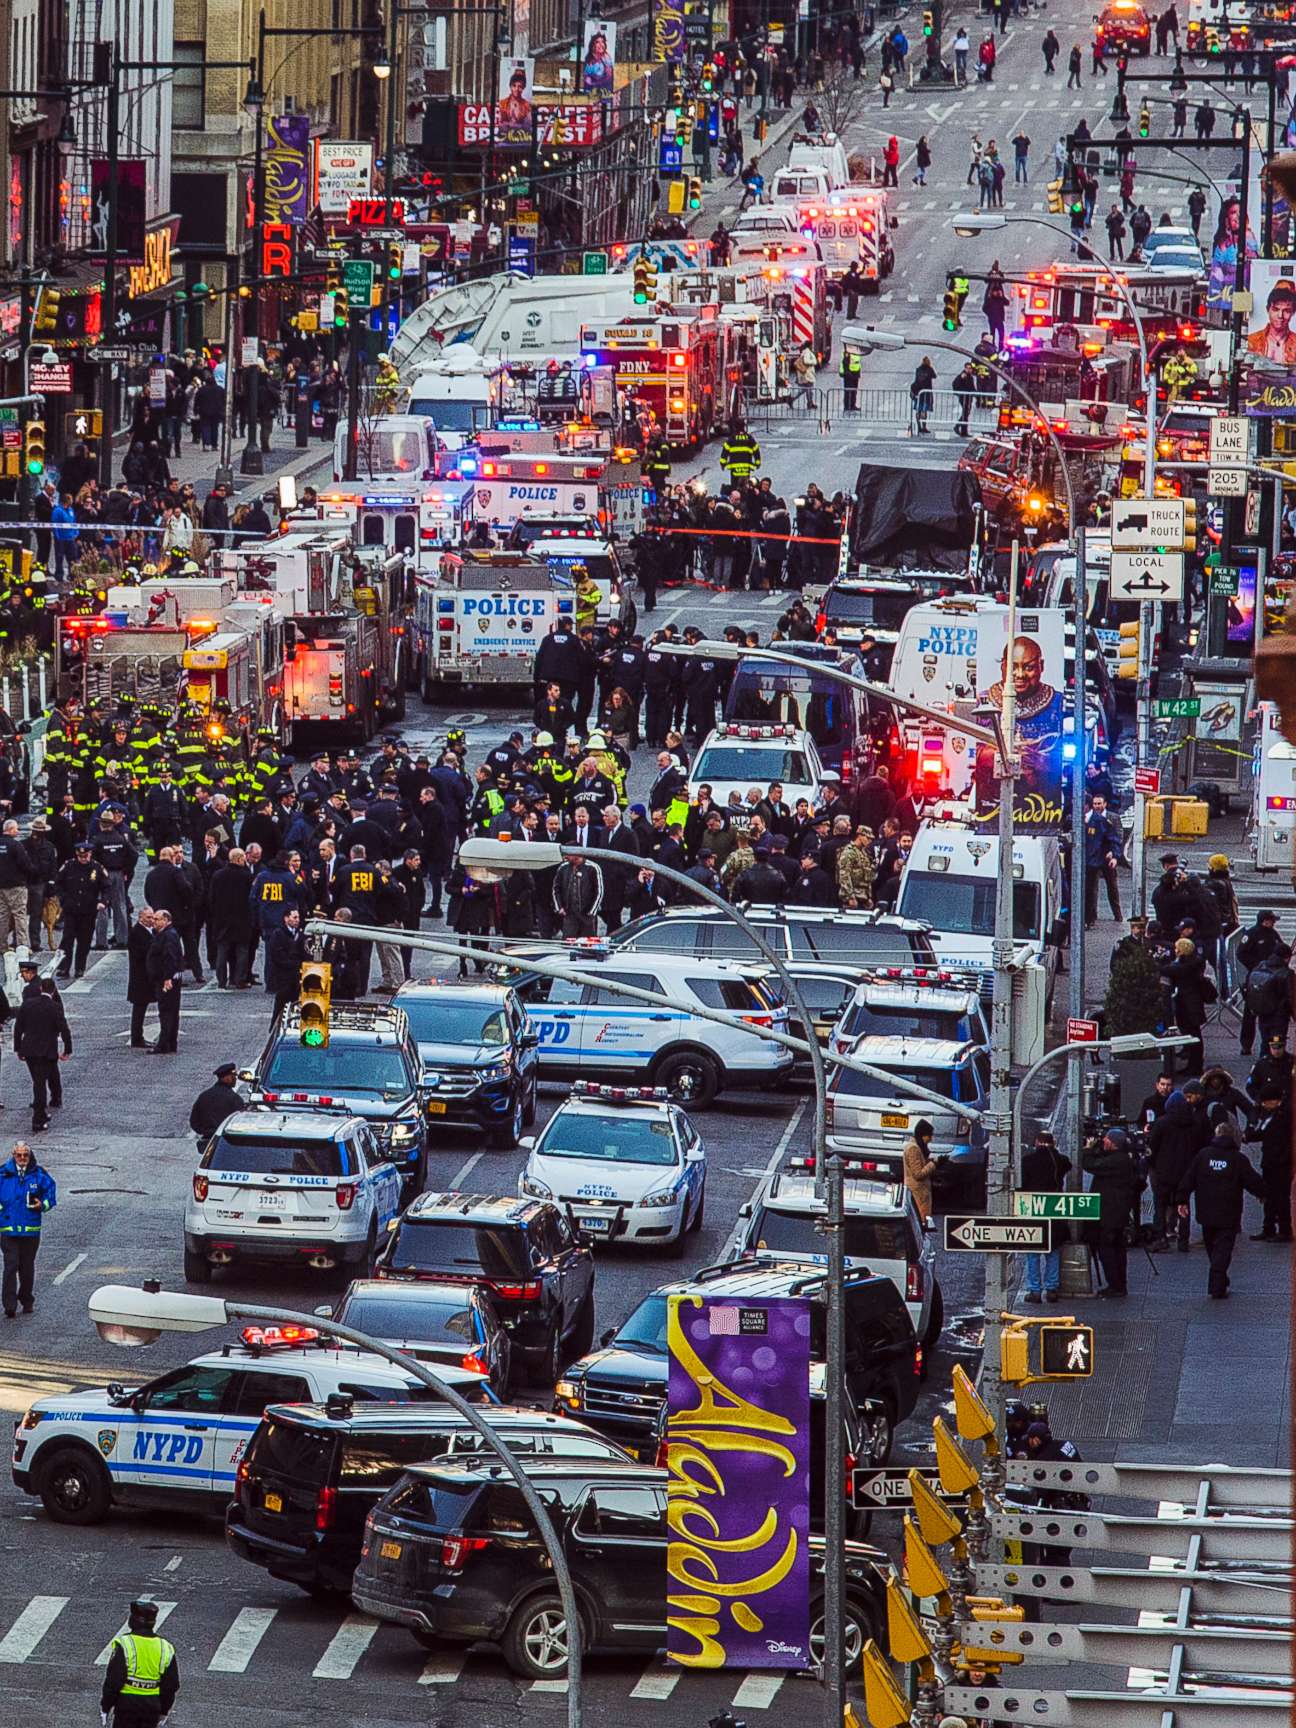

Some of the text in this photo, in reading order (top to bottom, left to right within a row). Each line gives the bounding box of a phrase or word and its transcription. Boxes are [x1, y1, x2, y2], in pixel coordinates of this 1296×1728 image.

[343, 147, 364, 156] PRICE
[328, 171, 357, 179] LUGGAGE
[349, 200, 405, 223] PIZZA
[138, 343, 158, 352] Club
[619, 360, 650, 373] FDNY
[1219, 422, 1240, 434] BUS
[1215, 437, 1242, 448] LANE
[1211, 472, 1237, 484] $205
[508, 486, 558, 500] POLICE
[1151, 511, 1181, 521] TRUCK
[1150, 526, 1180, 537] ROUTE
[1129, 557, 1164, 568] LOCAL
[1214, 582, 1234, 590] POUND
[463, 598, 545, 615] POLICE
[929, 627, 977, 641] NYPD
[473, 637, 536, 646] EMERGENCY SERVICE
[918, 640, 976, 656] POLIC
[1161, 700, 1199, 715] W 42 ST
[975, 791, 1064, 823] addin
[932, 844, 954, 852] NYPD
[352, 872, 373, 892] FBI
[262, 883, 283, 900] FBI
[941, 958, 986, 966] POLICE
[1209, 1159, 1227, 1168] NYPD
[220, 1173, 329, 1184] NYPD POLICE
[258, 1194, 279, 1205] 3723
[576, 1189, 618, 1198] POLICE
[1033, 1196, 1092, 1215] W 41 ST
[962, 1227, 1036, 1242] ONE WAY
[812, 1254, 851, 1268] NYD
[53, 1412, 84, 1421] POLICE
[133, 1431, 204, 1464] NYPD
[668, 1295, 797, 1667] Aladdin
[872, 1480, 904, 1497] ONE
[765, 1639, 801, 1657] Disney
